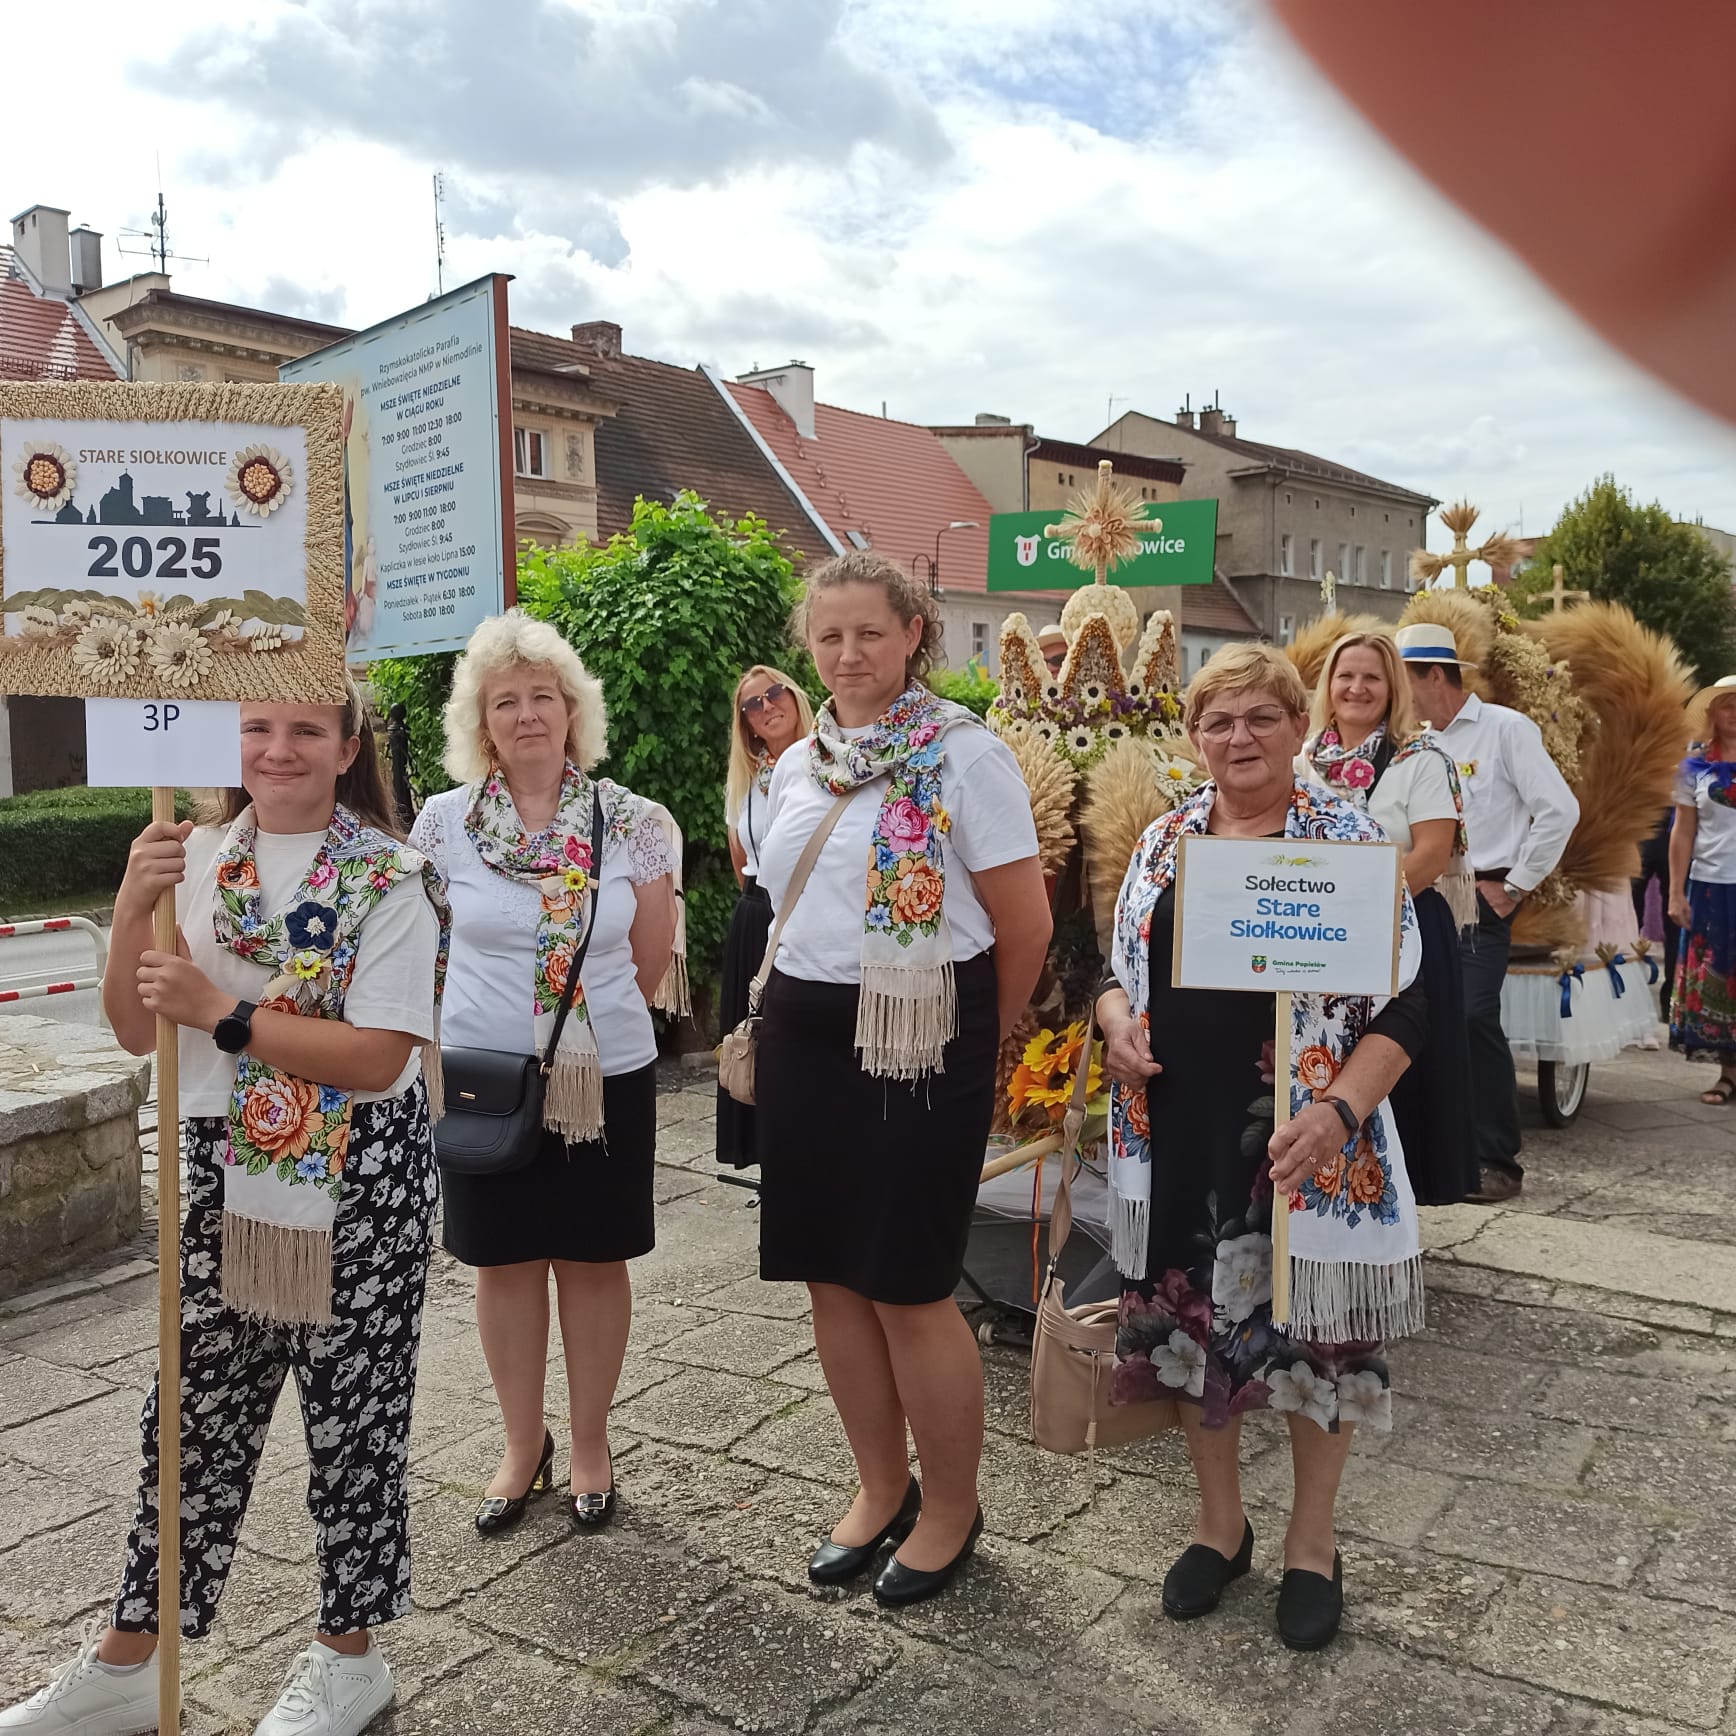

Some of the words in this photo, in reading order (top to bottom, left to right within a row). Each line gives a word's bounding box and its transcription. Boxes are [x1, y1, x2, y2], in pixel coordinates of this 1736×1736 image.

[379, 345, 434, 374] Rzymskokatolicka
[436, 334, 459, 352] Parafia
[372, 367, 417, 391] Wniebowzięcia
[419, 361, 434, 376] NMP
[442, 342, 482, 366] Niemodlinie
[381, 398, 397, 412] MSZE
[398, 389, 421, 406] ŚWIĘTE
[423, 375, 461, 397] NIEDZIELNE
[397, 412, 403, 421] W
[405, 402, 424, 419] CIĄGU
[426, 397, 444, 412] ROKU
[382, 434, 394, 446] 7:00
[397, 428, 409, 441] 9:00
[412, 424, 426, 436] 11:00
[428, 418, 442, 430] 12:30
[446, 412, 462, 425] 18:00
[402, 439, 427, 455] Grodziec
[428, 434, 441, 446] 8:00
[79, 449, 125, 464] STARE
[130, 450, 227, 466] SIOŁKOWICE
[396, 454, 428, 472] Szydłowiec
[436, 447, 449, 459] 9:45
[384, 479, 400, 493] MSZE
[401, 472, 425, 488] ŚWIĘTE
[426, 462, 464, 482] NIEDZIELNE
[394, 495, 400, 505] W
[401, 488, 420, 503] LIPCU
[425, 481, 454, 498] SIERPNIU
[394, 513, 406, 524] 7:00
[409, 509, 421, 520] 9:00
[423, 506, 437, 517] 11:00
[440, 501, 456, 513] 18:00
[405, 524, 430, 537] Grodziec
[432, 519, 445, 531] 8:00
[399, 538, 429, 554] Szydłowiec
[439, 533, 452, 545] 9:45
[87, 535, 222, 579] 2025
[380, 558, 406, 574] Kapliczka
[408, 559, 412, 567] w
[414, 555, 426, 567] lesie
[428, 552, 440, 565] koło
[442, 550, 458, 563] Lipna
[459, 545, 475, 557] 15:00
[387, 578, 403, 590] MSZE
[404, 572, 427, 588] ŚWIĘTE
[428, 572, 435, 582] W
[437, 566, 470, 581] TYGODNIU
[384, 593, 419, 610] Poniedziałek
[423, 589, 441, 602] Piątek
[443, 588, 455, 600] 6:30
[459, 586, 475, 598] 18:00
[403, 608, 422, 622] Sobota
[423, 606, 436, 618] 8:00
[439, 605, 454, 616] 18:00
[143, 704, 180, 731] 3P
[1245, 875, 1335, 894] Sołectwo
[1257, 898, 1320, 917] Stare
[1230, 920, 1347, 942] Siołkowice
